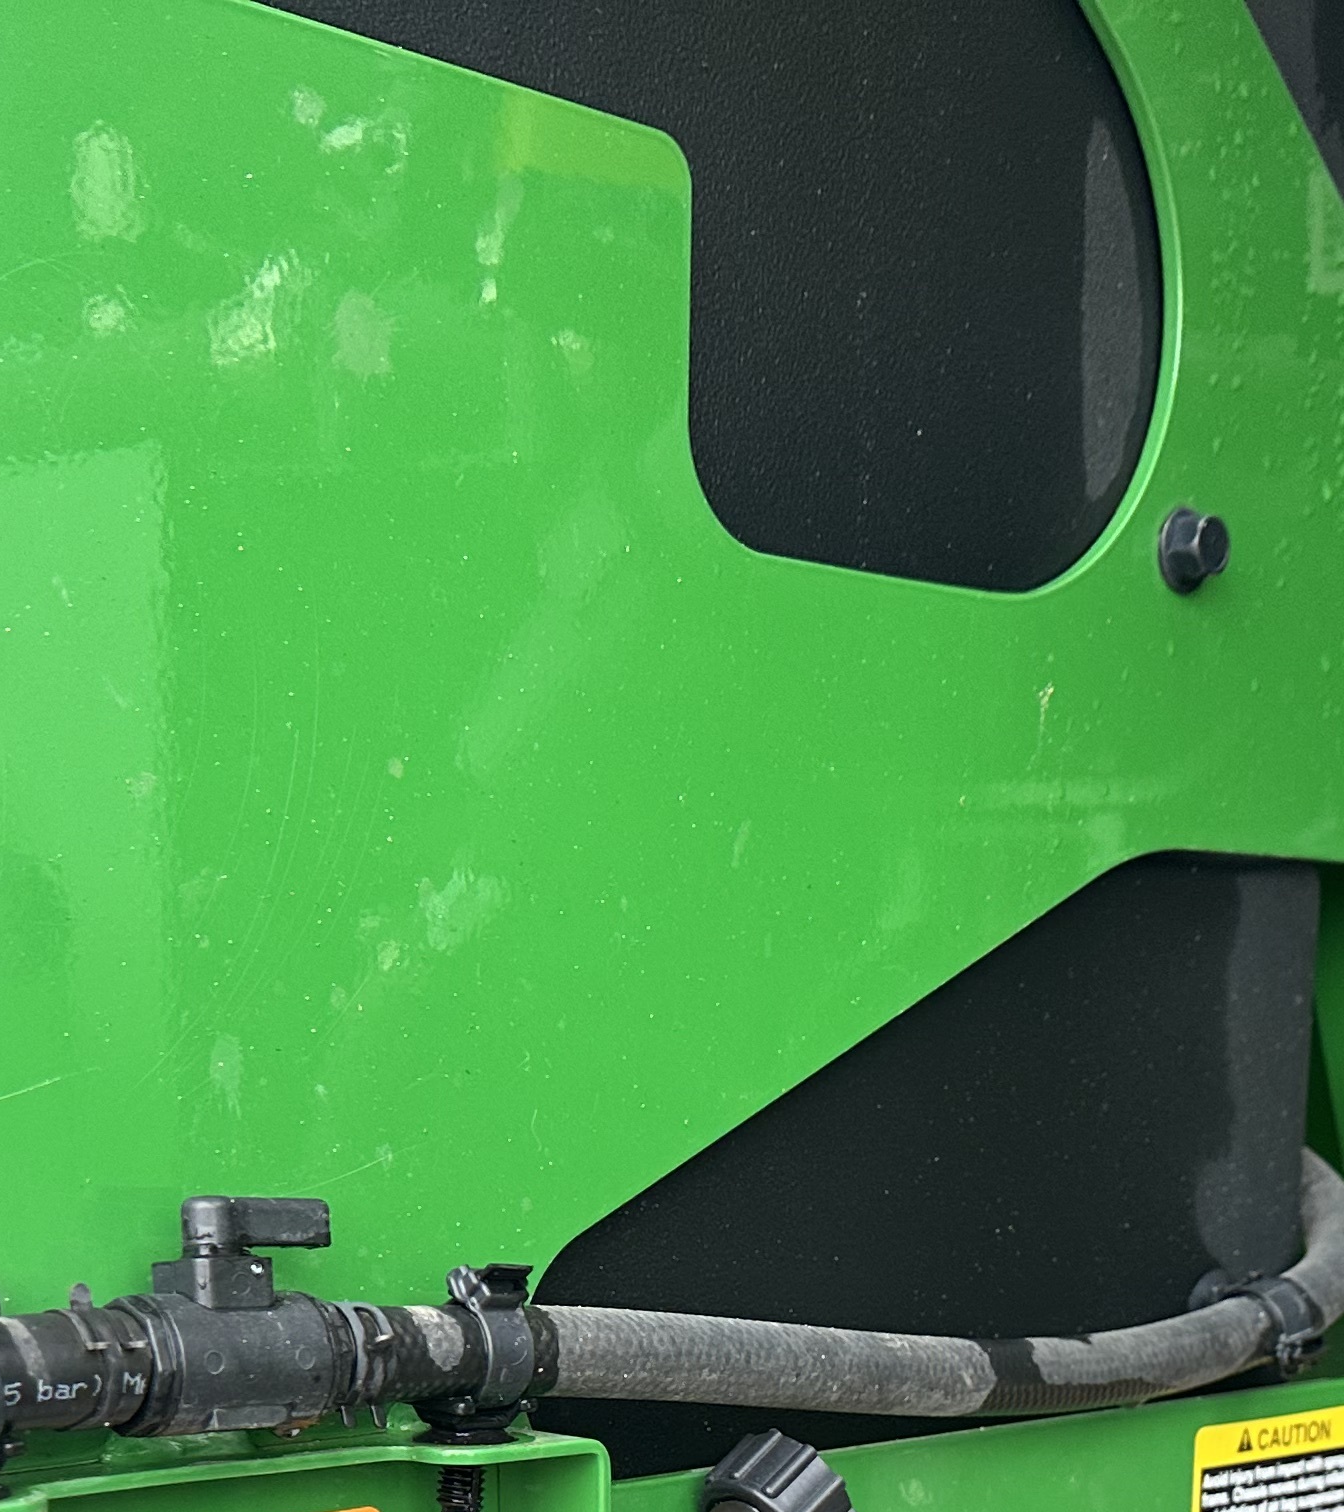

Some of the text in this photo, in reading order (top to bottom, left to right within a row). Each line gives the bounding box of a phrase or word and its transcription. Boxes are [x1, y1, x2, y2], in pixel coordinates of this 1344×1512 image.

[3, 1381, 22, 1406] 5
[37, 1374, 102, 1402] bar)
[1257, 1420, 1332, 1451] CAUTION
